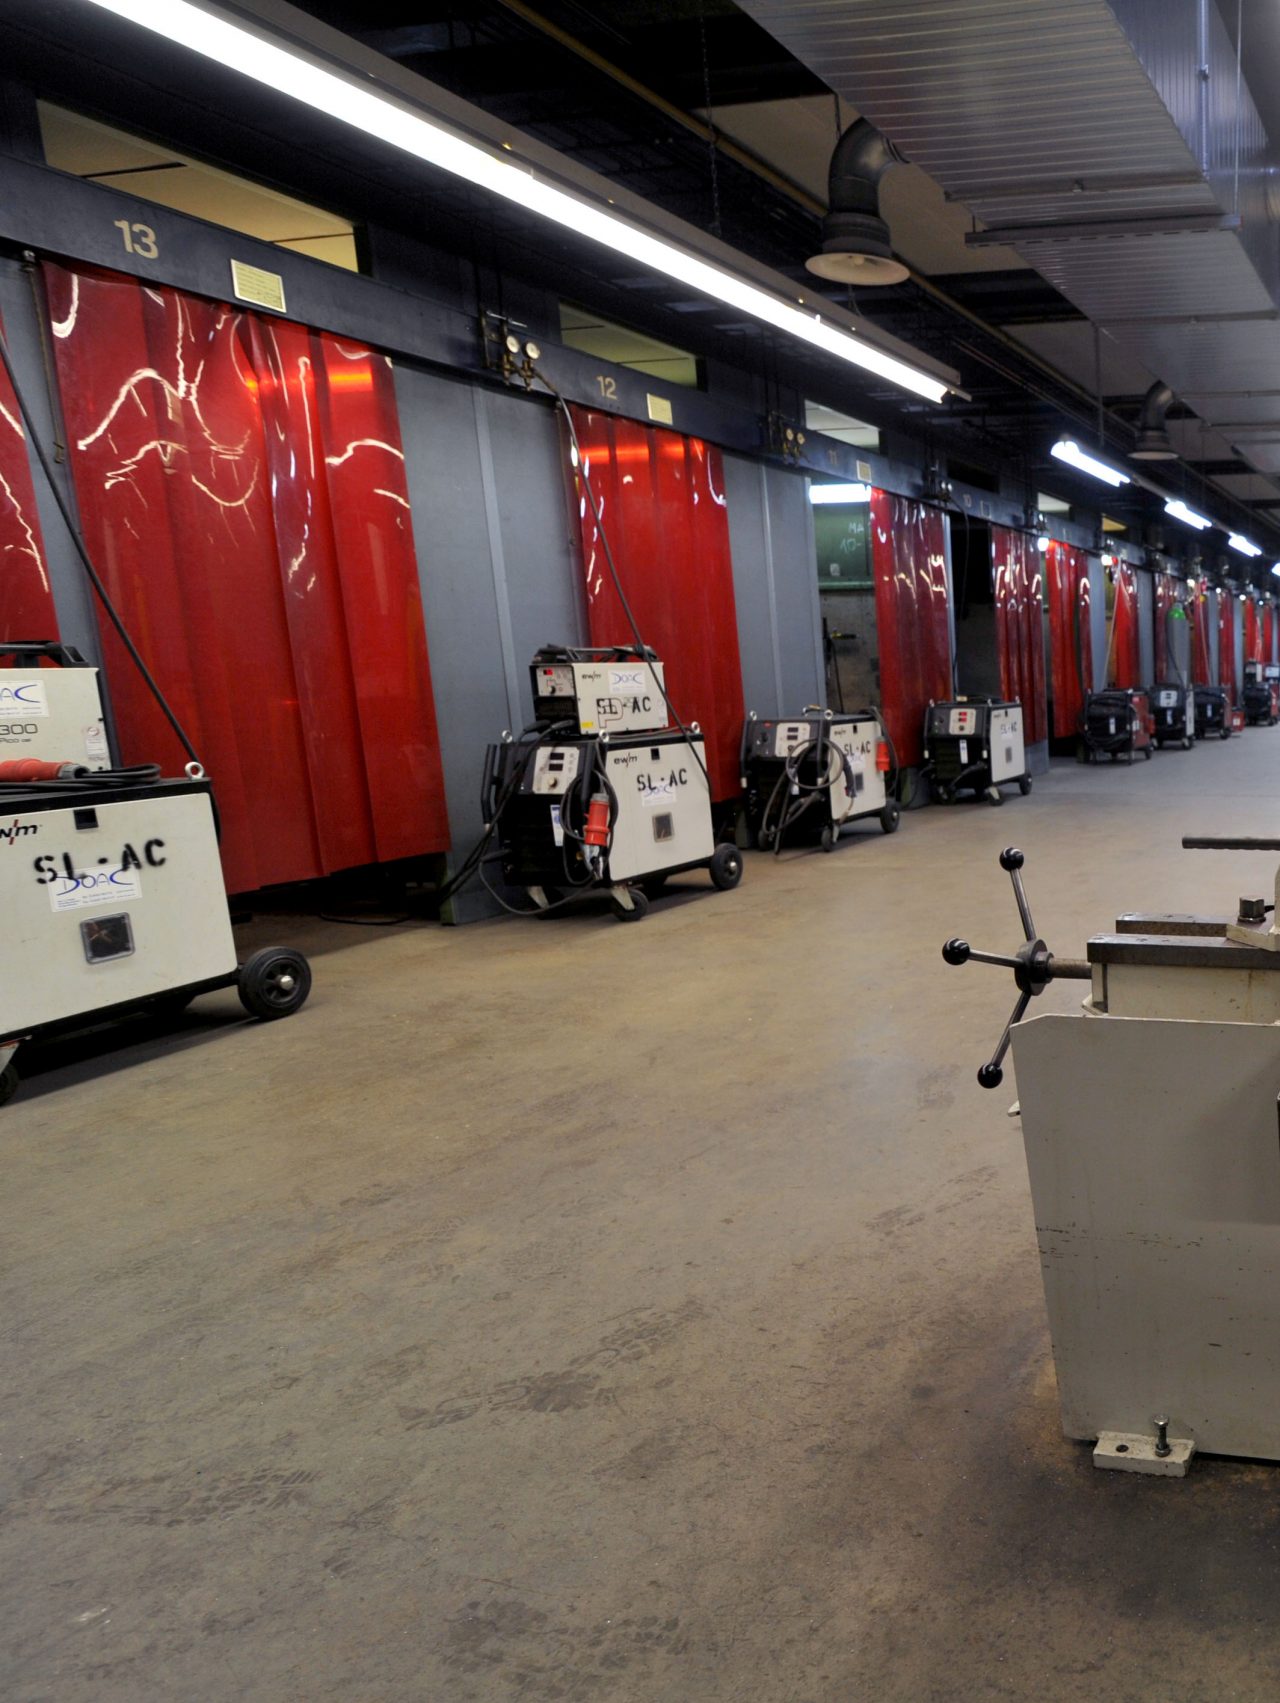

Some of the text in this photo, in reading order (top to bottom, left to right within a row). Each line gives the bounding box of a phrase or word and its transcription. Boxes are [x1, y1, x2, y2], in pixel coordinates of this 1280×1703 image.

[114, 219, 159, 259] 13
[596, 376, 617, 400] 12
[33, 839, 167, 884] SL-AC
[55, 868, 134, 896] DOAC
